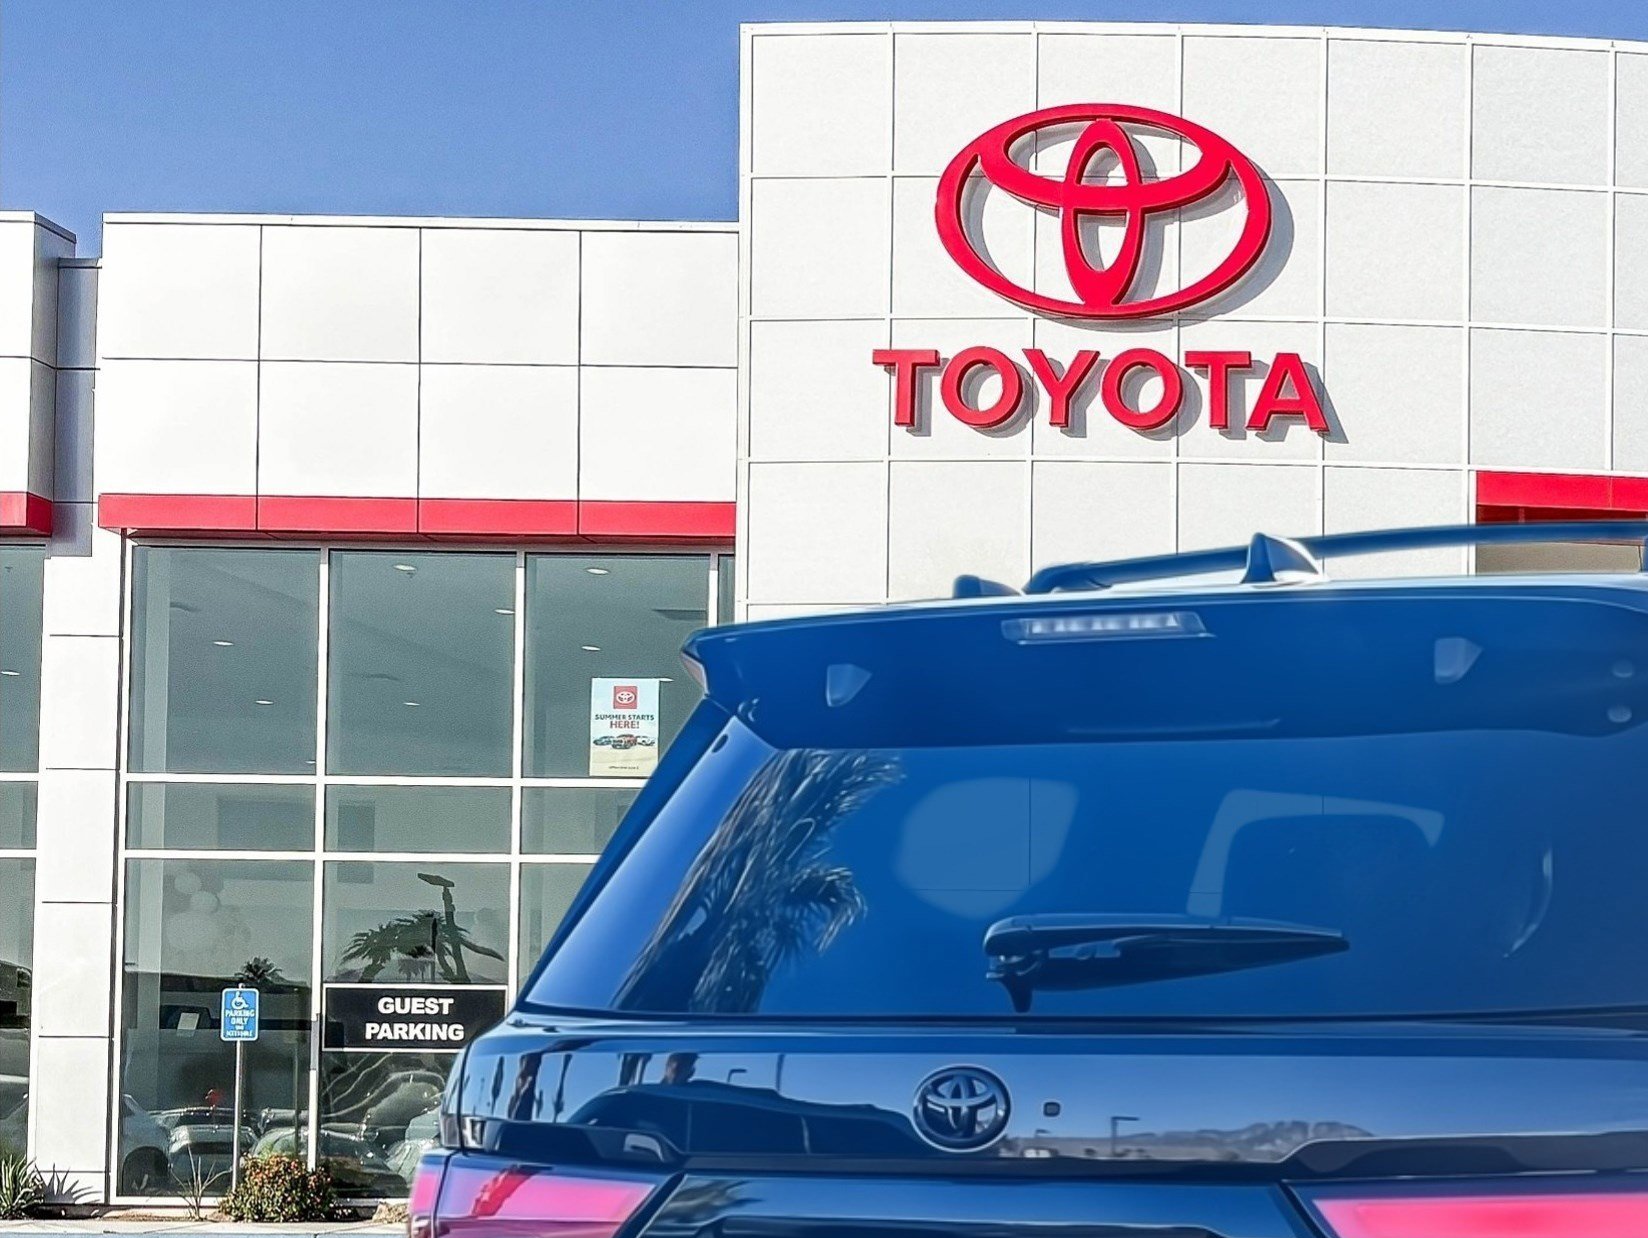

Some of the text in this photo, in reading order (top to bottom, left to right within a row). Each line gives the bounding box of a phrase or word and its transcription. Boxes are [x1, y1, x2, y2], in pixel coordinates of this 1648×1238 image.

[872, 346, 1330, 432] TOYOTA
[609, 720, 640, 729] HERE!
[225, 1009, 255, 1018] PARKING
[377, 996, 454, 1015] GUEST
[365, 1022, 465, 1041] PARKING
